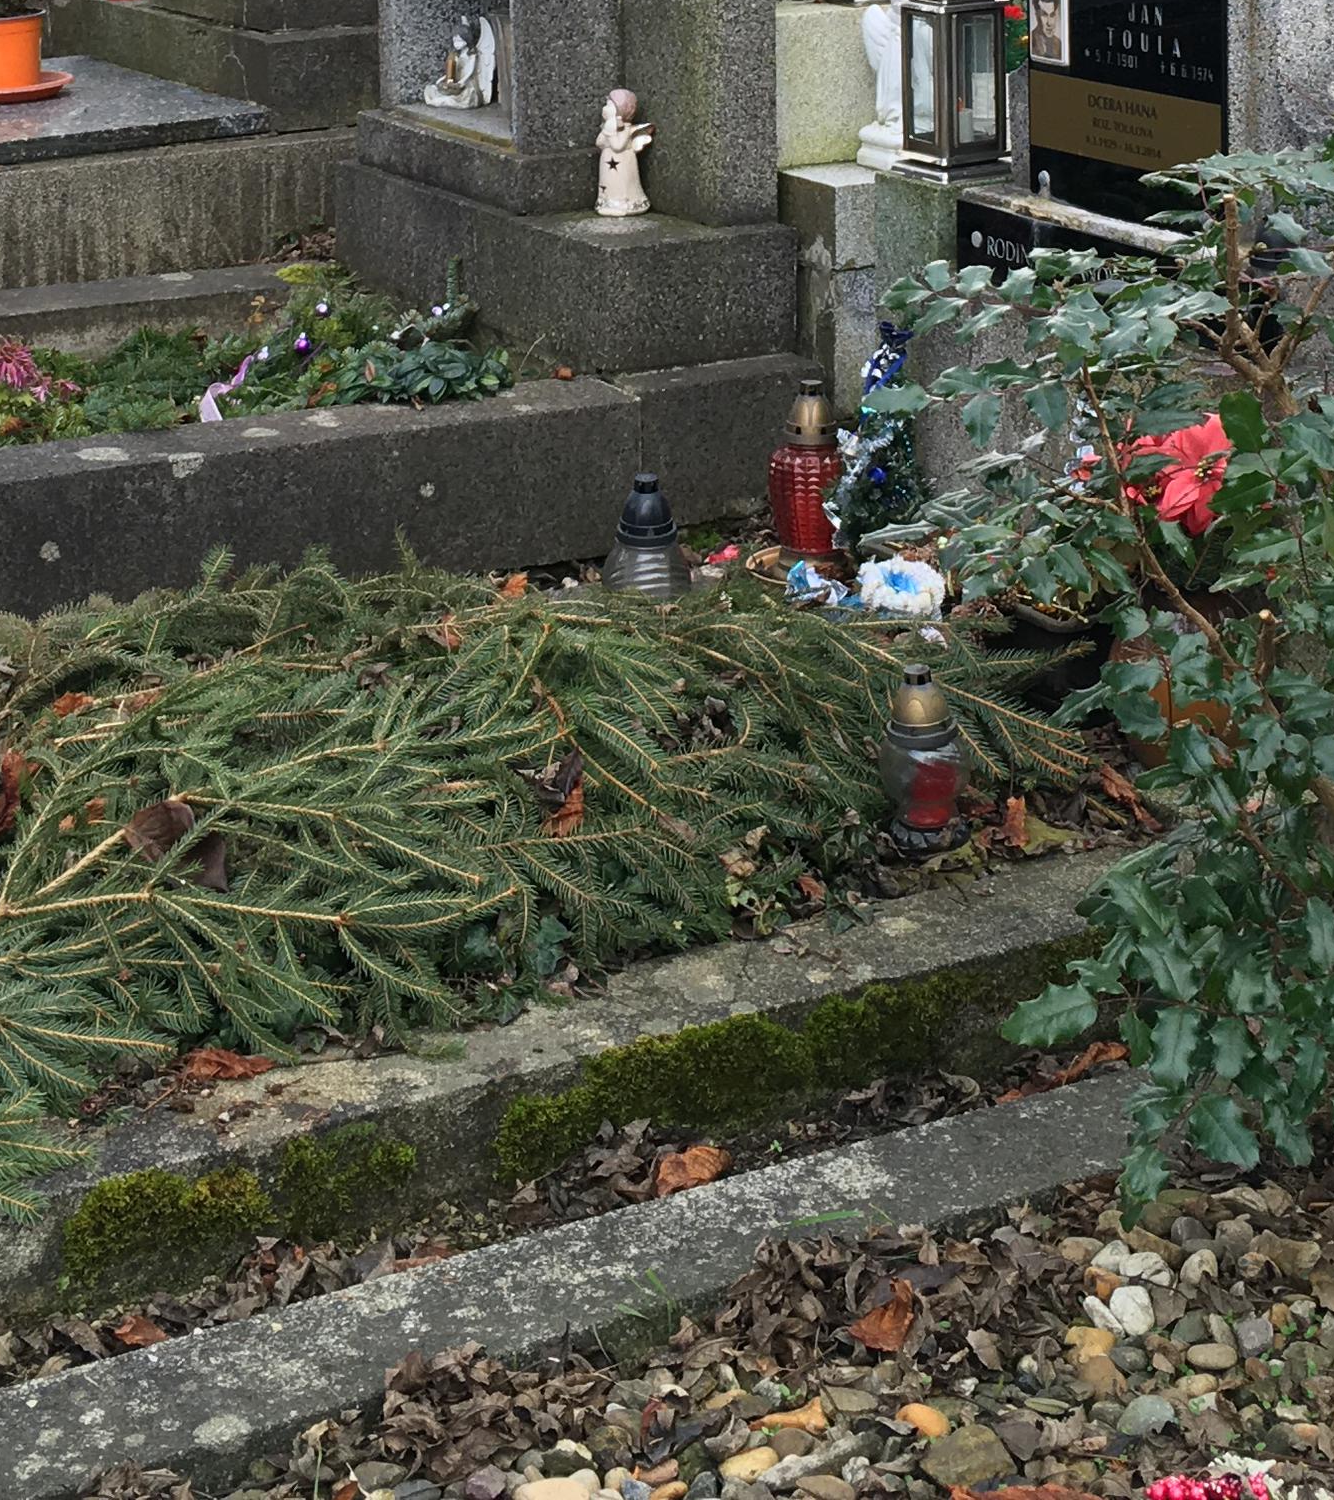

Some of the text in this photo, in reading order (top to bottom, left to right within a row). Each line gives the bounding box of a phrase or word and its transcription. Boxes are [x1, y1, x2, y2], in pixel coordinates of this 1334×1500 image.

[1127, 2, 1163, 27] JAN
[1106, 26, 1182, 59] TOULA
[1087, 93, 1159, 121] DCERA HANA
[985, 234, 1031, 265] RODIN
